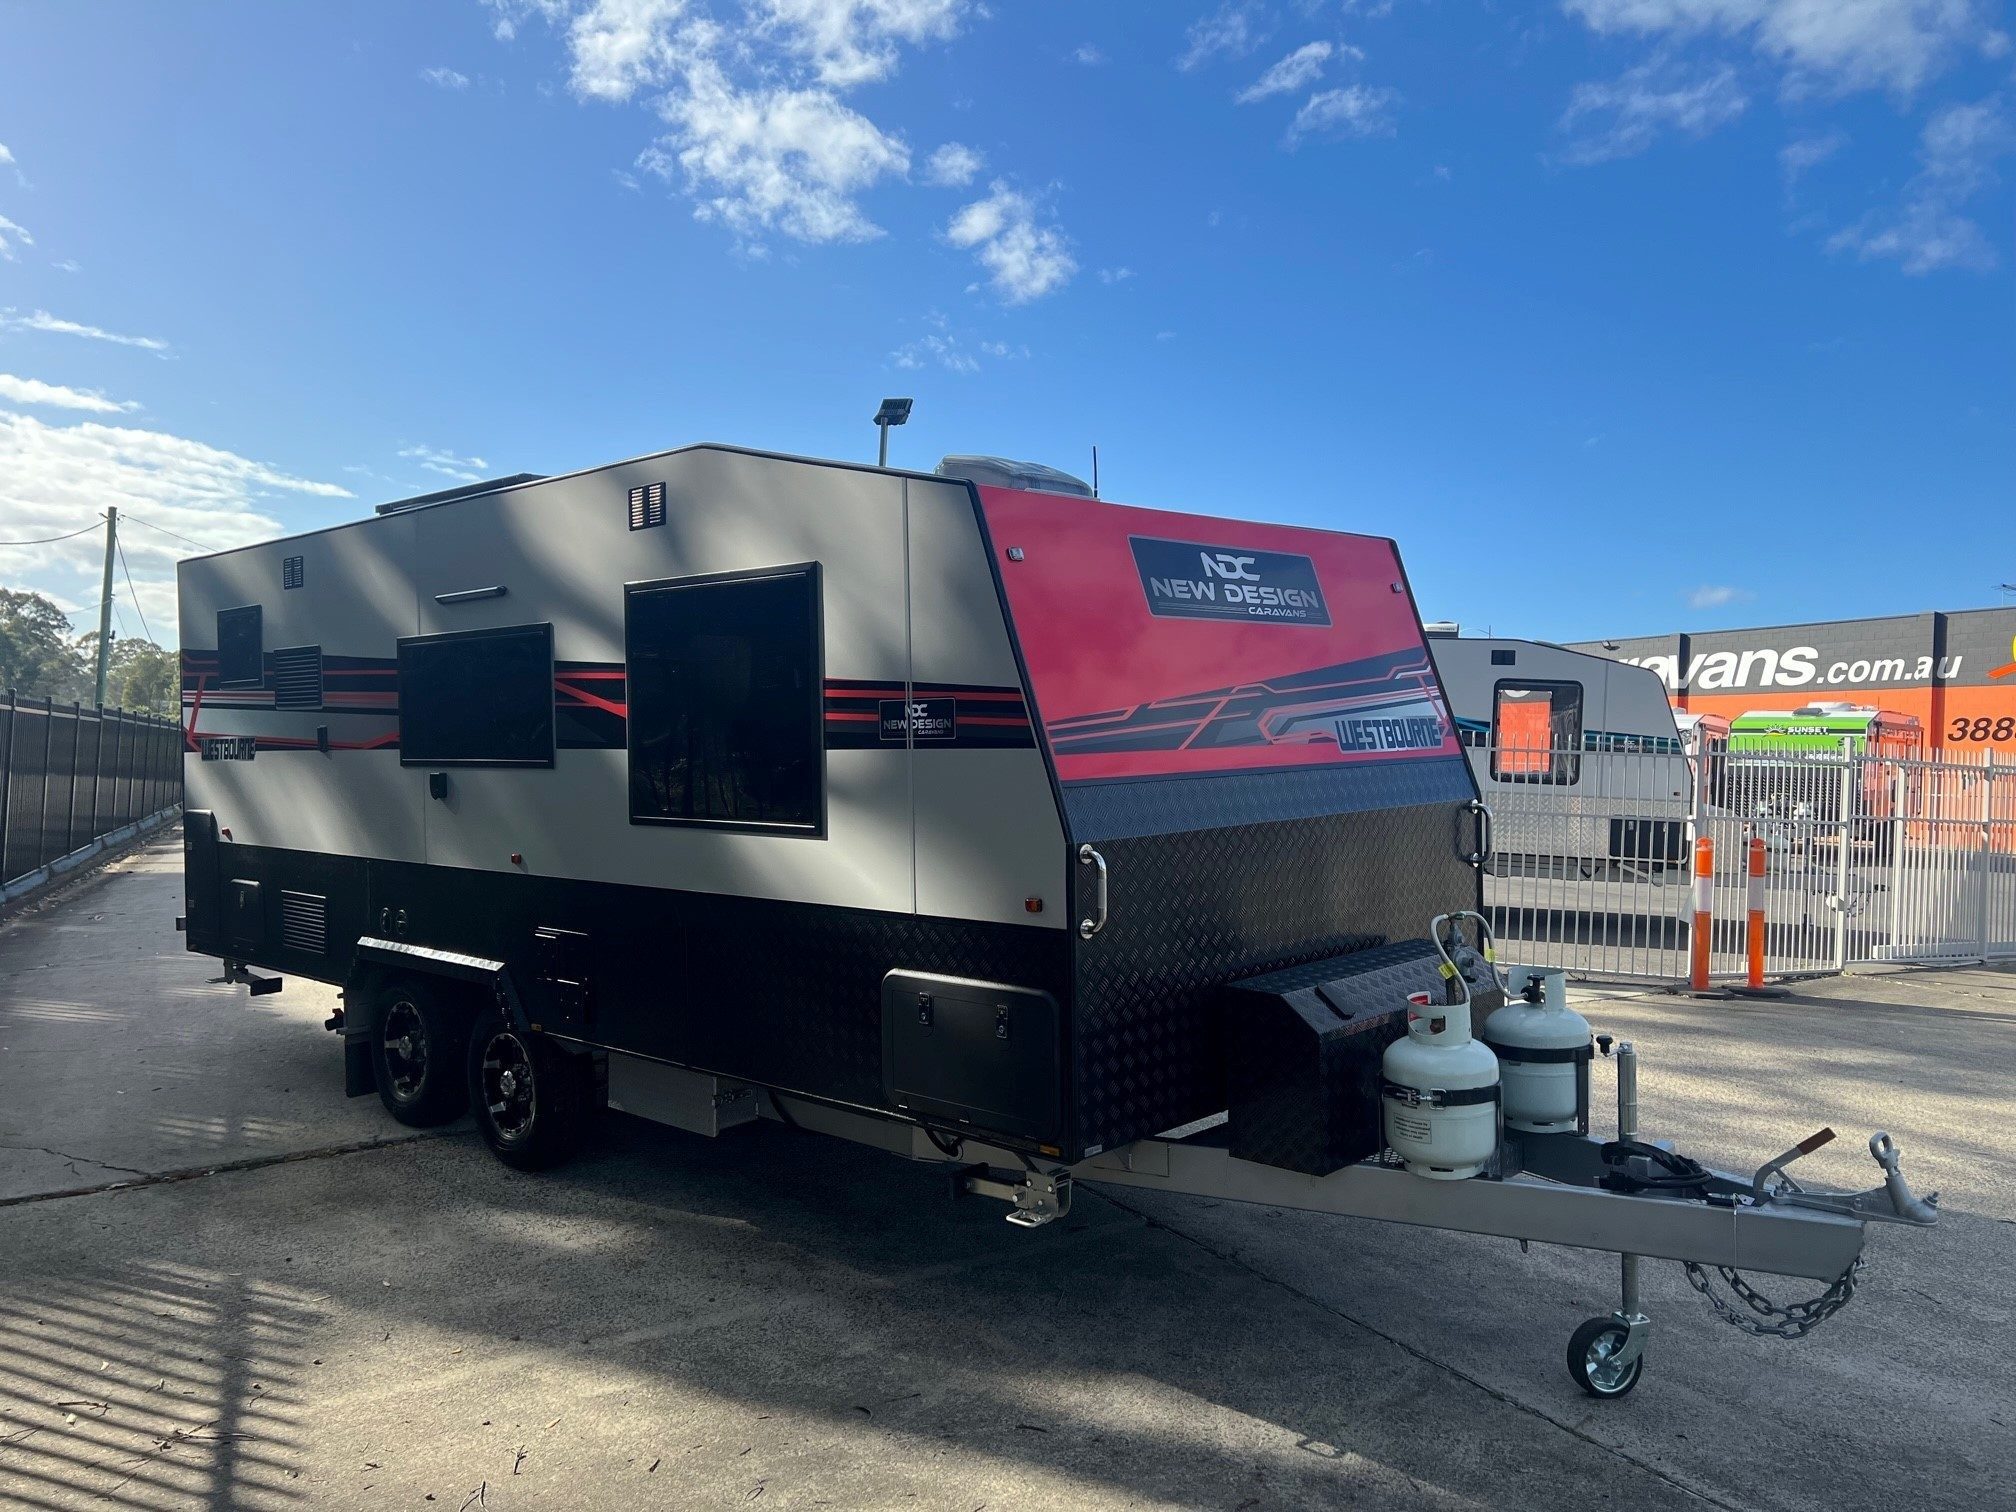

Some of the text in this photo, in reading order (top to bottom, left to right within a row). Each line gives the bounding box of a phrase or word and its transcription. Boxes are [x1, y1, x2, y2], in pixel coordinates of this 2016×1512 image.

[1200, 551, 1261, 582] NDC
[1150, 576, 1319, 608] NEW DESIGN
[1248, 606, 1307, 618] CARAVANS
[883, 718, 952, 730] NEW DESIGN
[1335, 718, 1442, 752] WESTBOURNE
[201, 737, 256, 761] WESTBOURNE
